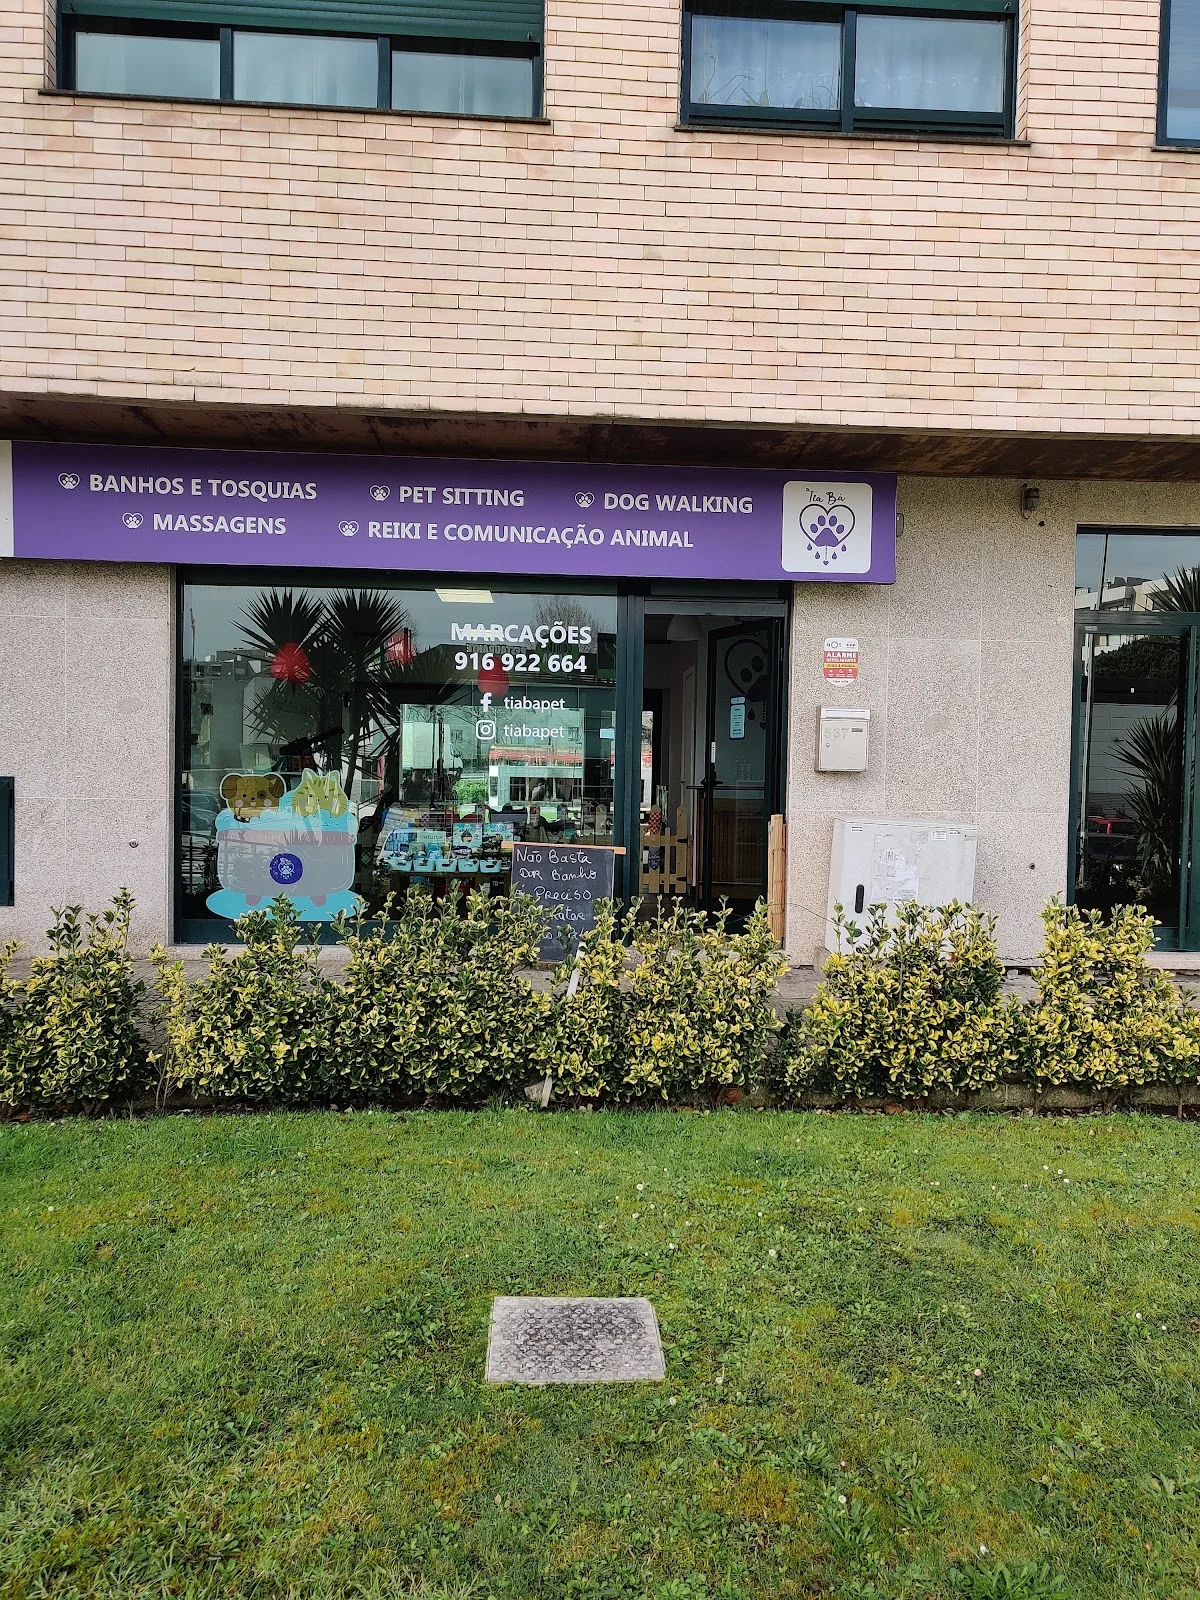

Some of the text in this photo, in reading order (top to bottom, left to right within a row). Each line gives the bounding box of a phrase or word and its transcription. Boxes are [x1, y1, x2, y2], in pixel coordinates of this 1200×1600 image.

[89, 474, 317, 503] BANHOS E TOSQUIAS
[399, 486, 525, 507] PET SITTING
[604, 493, 753, 514] DOG WALKING
[153, 513, 287, 535] MASSAGENS
[368, 521, 694, 549] REIKI E COMUNICAÇÃO ANIMAL
[451, 621, 592, 648] MARCAÇÕES
[454, 652, 495, 671] 916
[501, 653, 540, 672] 922
[547, 654, 587, 673] 664
[503, 695, 566, 713] tiabapet
[503, 723, 565, 741] tiabapet
[824, 727, 850, 739] 537
[516, 847, 592, 864] Não Basta
